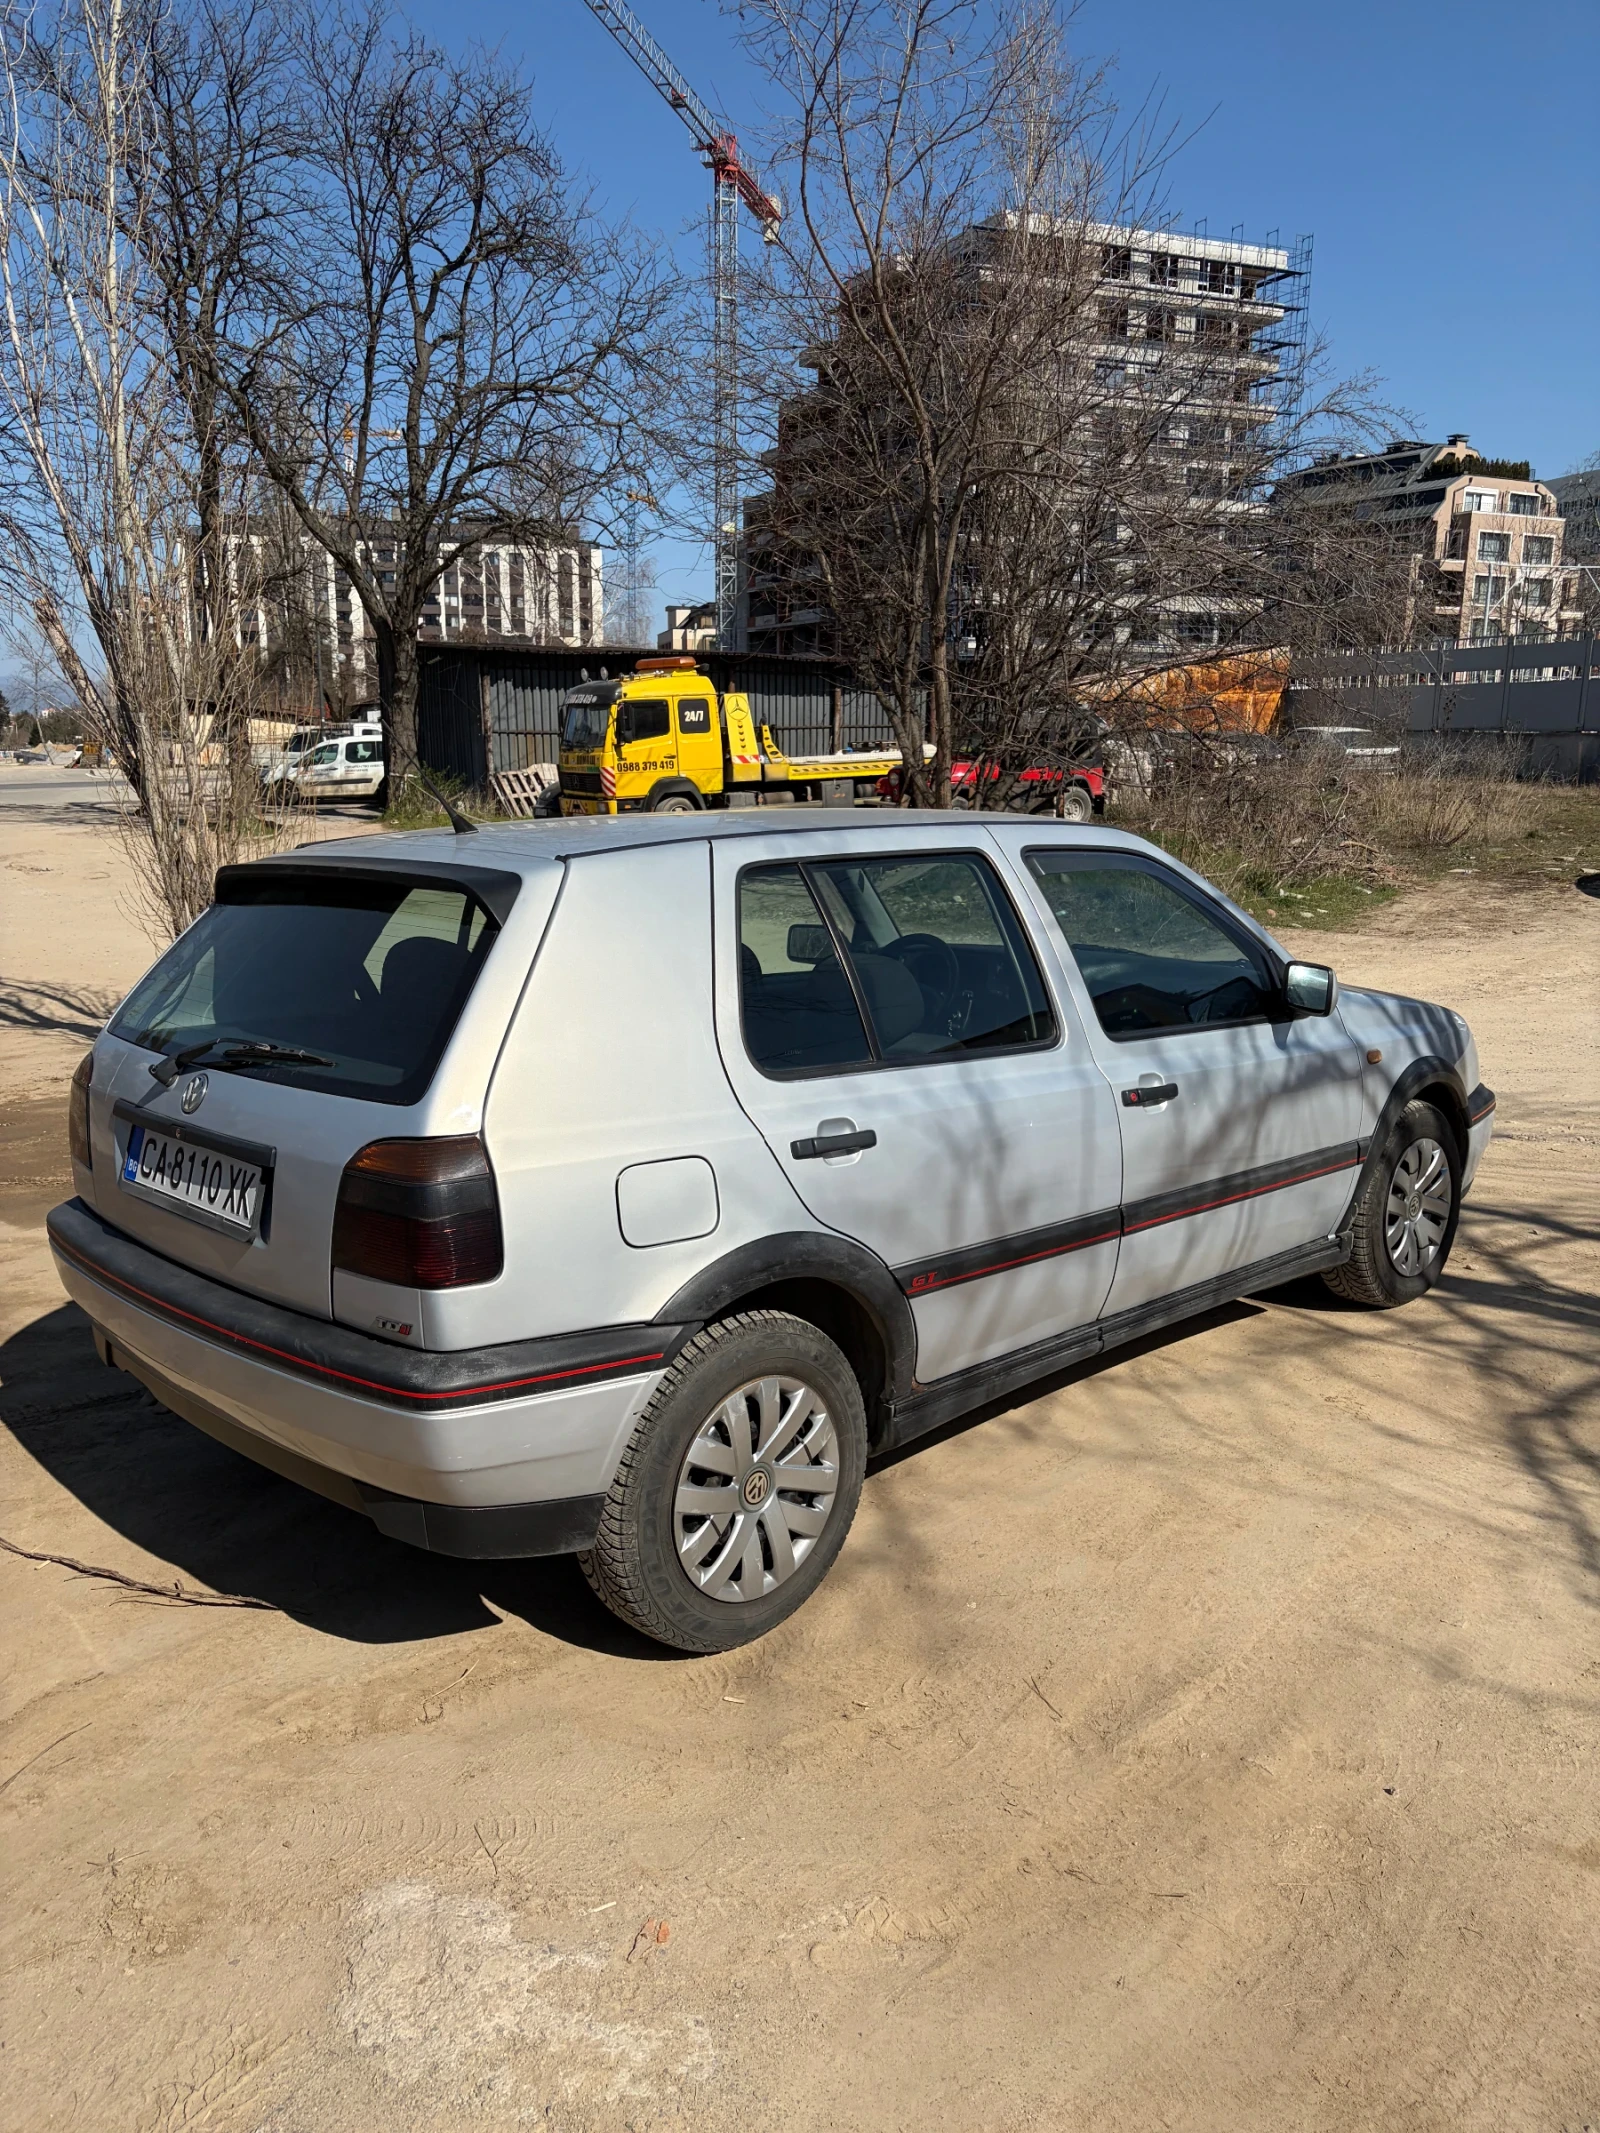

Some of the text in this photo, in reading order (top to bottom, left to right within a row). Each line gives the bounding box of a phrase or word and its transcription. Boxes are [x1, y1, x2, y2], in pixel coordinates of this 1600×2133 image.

[684, 710, 704, 722] 24/7
[616, 760, 674, 772] 0988 379 419
[128, 1158, 138, 1172] BG
[911, 1271, 938, 1287] GT
